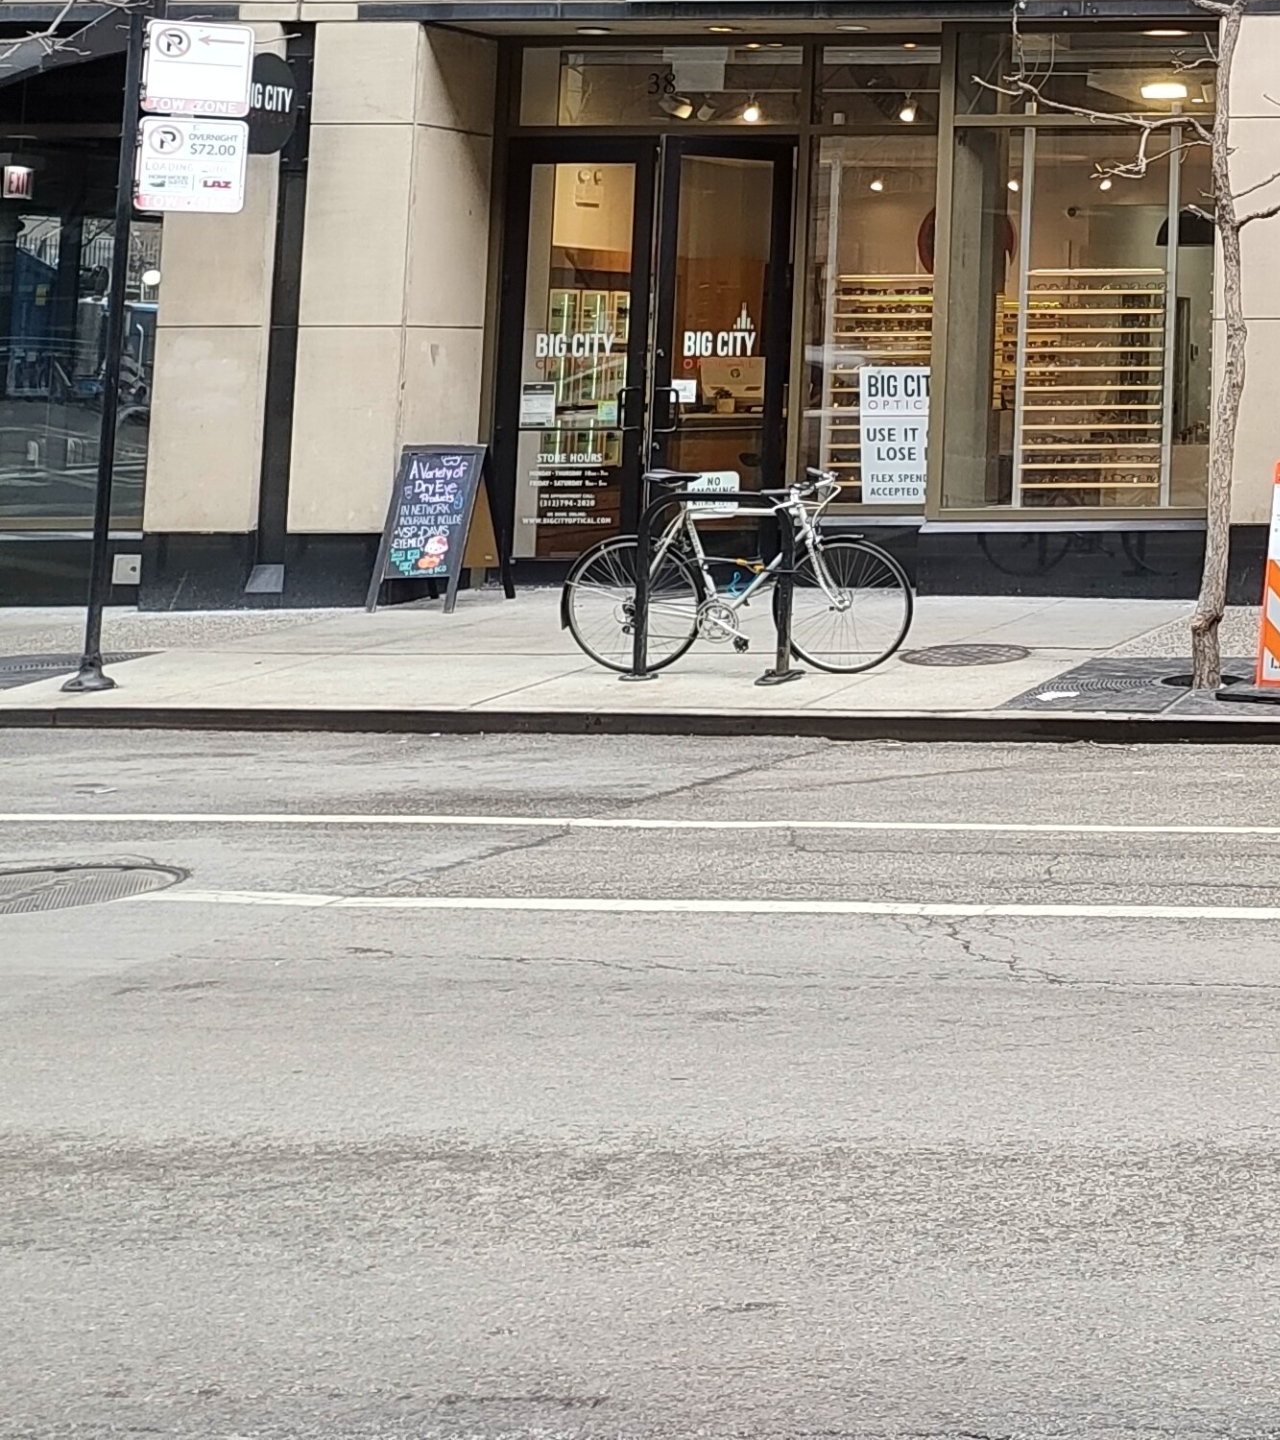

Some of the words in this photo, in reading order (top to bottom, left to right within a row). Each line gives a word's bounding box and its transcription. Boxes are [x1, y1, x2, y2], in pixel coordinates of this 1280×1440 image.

[648, 73, 676, 94] 38
[250, 82, 263, 109] IG
[264, 84, 293, 113] CITY
[150, 97, 184, 110] TOW
[194, 100, 238, 114] ZONE
[188, 133, 238, 142] OVERNIGHT
[190, 144, 236, 156] $72.00
[145, 161, 194, 172] LOADING
[203, 180, 232, 189] LAZ
[142, 196, 179, 208] TOW
[536, 334, 567, 357] BIG
[572, 334, 615, 357] CITY
[683, 331, 712, 356] BIG
[716, 331, 756, 357] CITY
[868, 374, 898, 398] BIG
[904, 374, 931, 398] CIT
[868, 400, 929, 410] OPTIC
[866, 427, 896, 442] USE
[904, 427, 919, 442] IT
[537, 453, 567, 463] STORE
[569, 453, 603, 463] HOURS
[877, 447, 917, 461] LOSE
[409, 460, 419, 480] A
[419, 462, 453, 480] Variety
[453, 462, 469, 479] of
[707, 477, 721, 486] NO
[870, 474, 894, 483] FLEX
[898, 474, 927, 483] SPEND
[414, 480, 434, 495] Dry
[435, 480, 458, 494] Eye
[870, 488, 919, 497] ACCEPTED
[400, 505, 410, 516] IN
[411, 503, 451, 515] NETWORK
